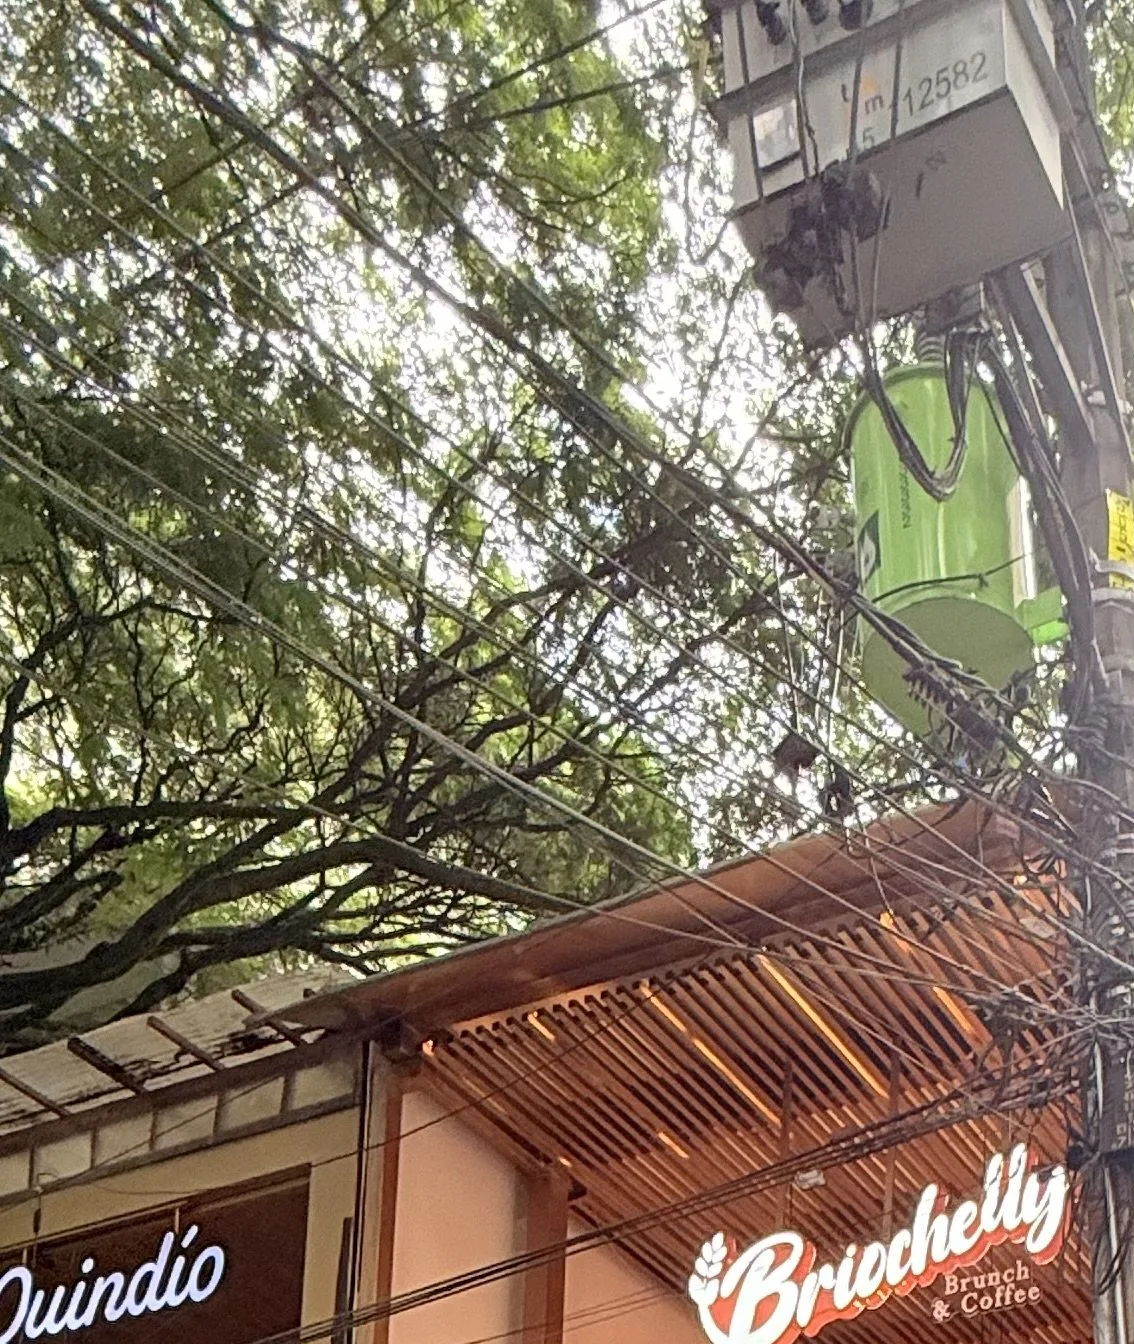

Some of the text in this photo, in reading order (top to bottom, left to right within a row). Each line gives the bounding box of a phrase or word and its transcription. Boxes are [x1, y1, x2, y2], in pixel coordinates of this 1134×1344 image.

[903, 51, 988, 117] 12582
[944, 1260, 1031, 1296] Brunch
[931, 1285, 1042, 1323] & Coffee
